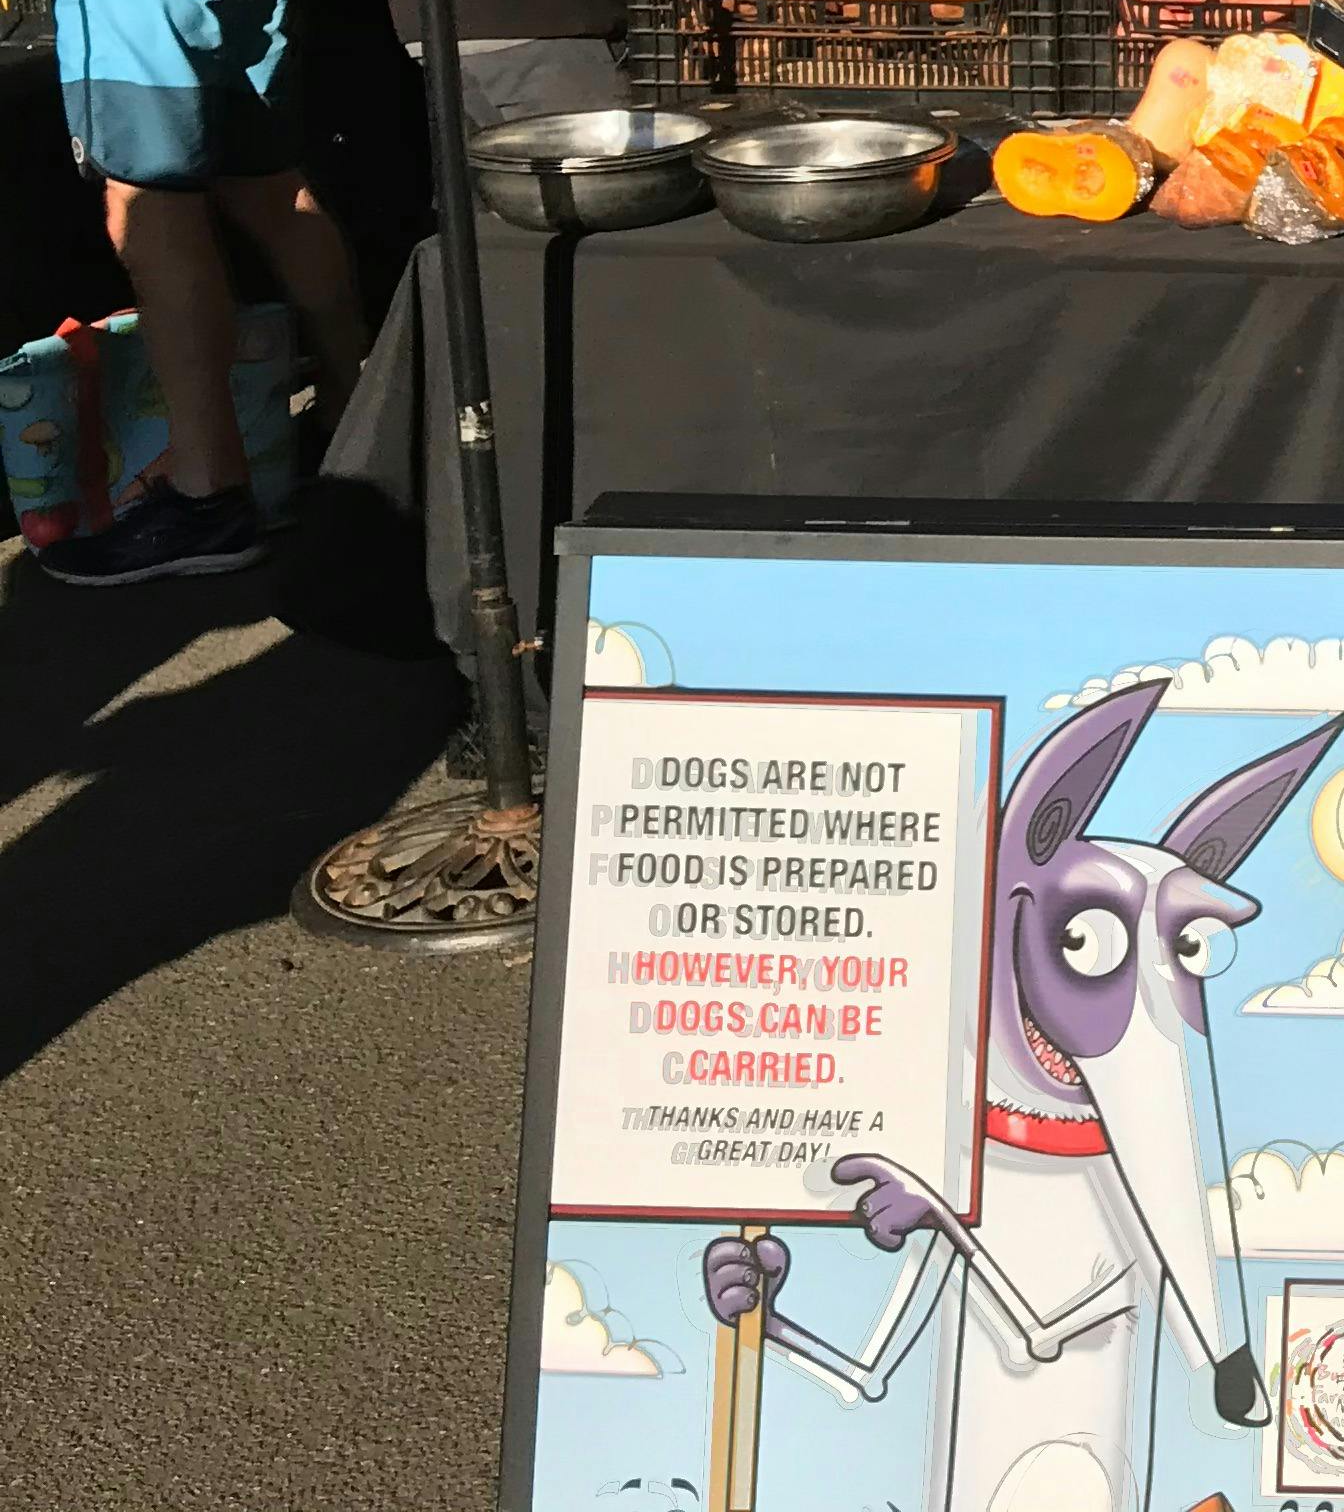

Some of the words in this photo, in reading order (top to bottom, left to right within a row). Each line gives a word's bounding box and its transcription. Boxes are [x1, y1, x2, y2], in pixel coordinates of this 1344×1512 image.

[662, 757, 749, 790] DOGS
[762, 760, 827, 791] ARE
[841, 762, 906, 793] NOT
[620, 804, 809, 839] PERMITTED
[824, 810, 942, 843] WHERE
[618, 853, 704, 886] FOOD
[719, 855, 749, 887] IS
[762, 857, 938, 891] PREPARED
[678, 902, 720, 935] OR
[734, 904, 874, 938] STORED.
[635, 950, 808, 987] HOWEVER,
[821, 956, 909, 987] YOUR
[656, 1000, 746, 1033] DOGS
[760, 1002, 827, 1034] CAN
[841, 1005, 883, 1036] BE
[688, 1049, 845, 1084] CARRIED.
[647, 1105, 740, 1129] THANKS
[749, 1107, 796, 1130] AND
[803, 1110, 865, 1132] HAVE
[869, 1111, 884, 1132] A
[698, 1139, 773, 1162] GREAT
[778, 1141, 832, 1163] DAY!
